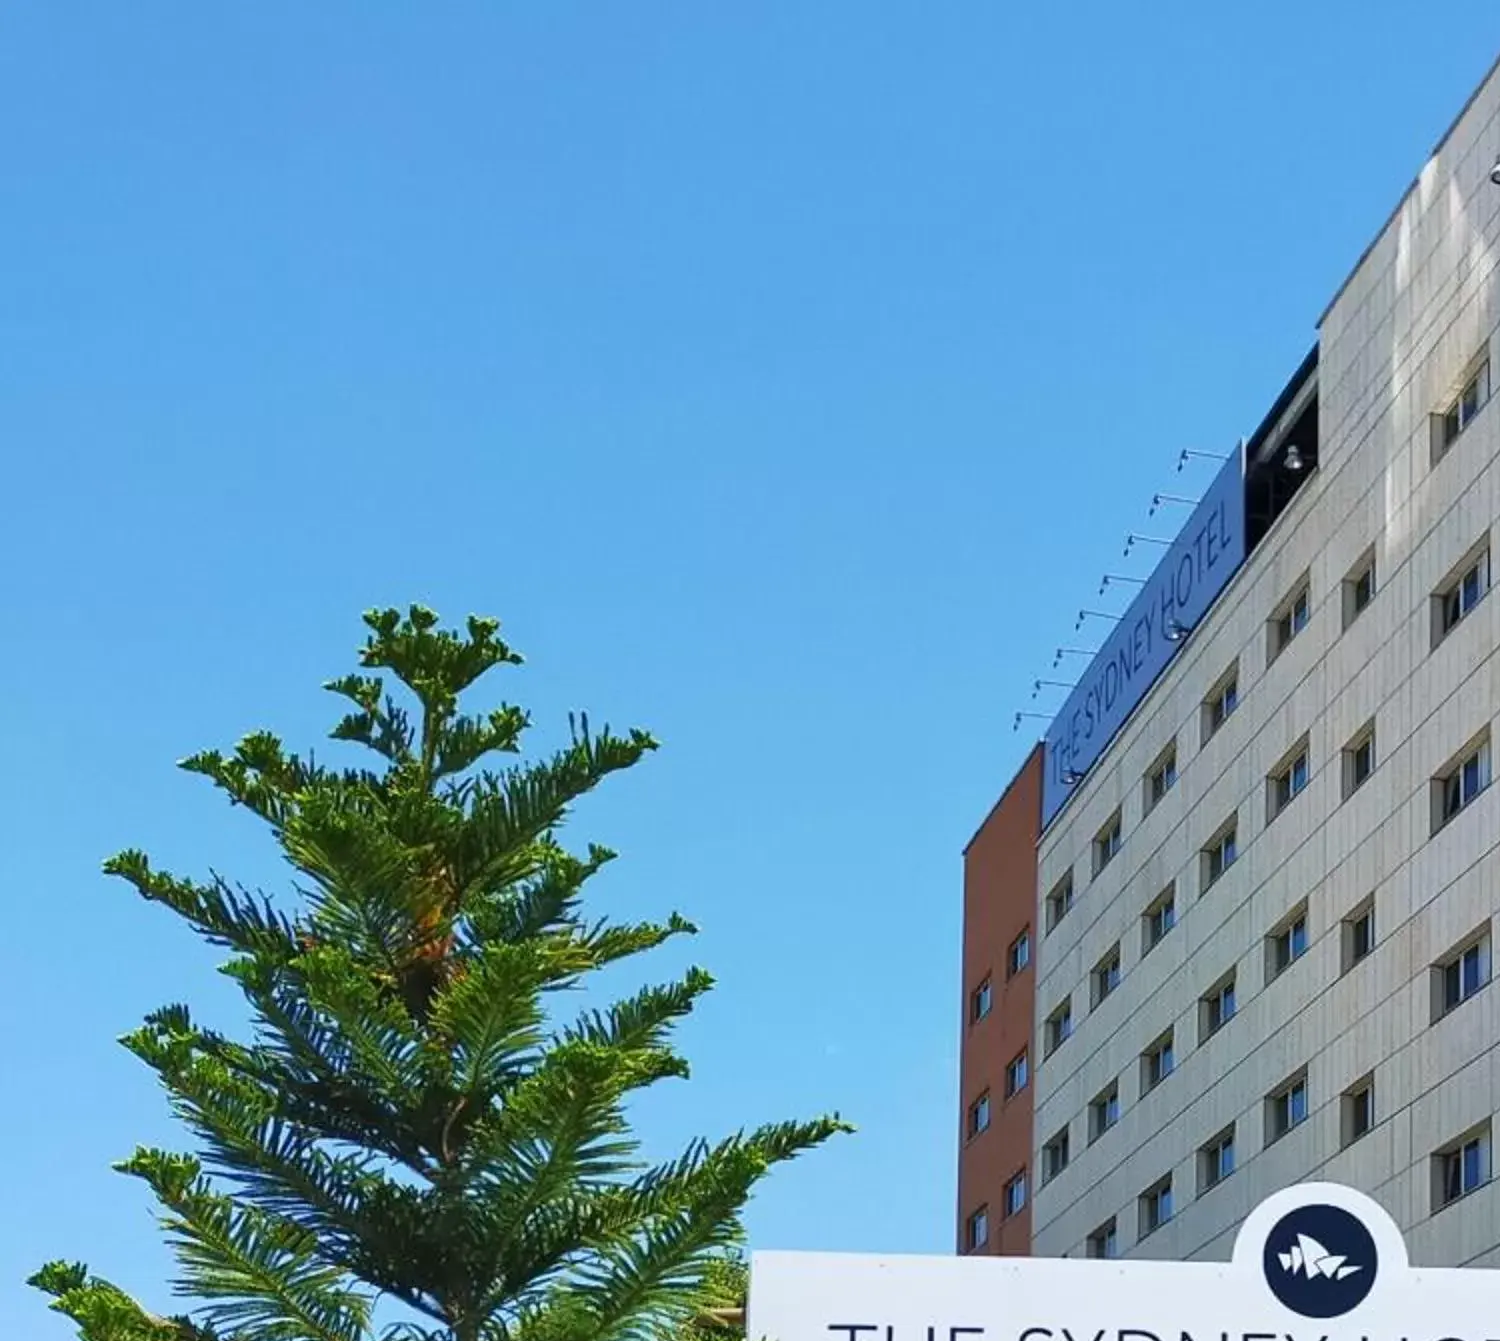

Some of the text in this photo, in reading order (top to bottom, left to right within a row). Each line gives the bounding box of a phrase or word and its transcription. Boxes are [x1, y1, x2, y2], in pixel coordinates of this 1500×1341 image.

[1051, 500, 1232, 785] THE SYDNEY HOTEL
